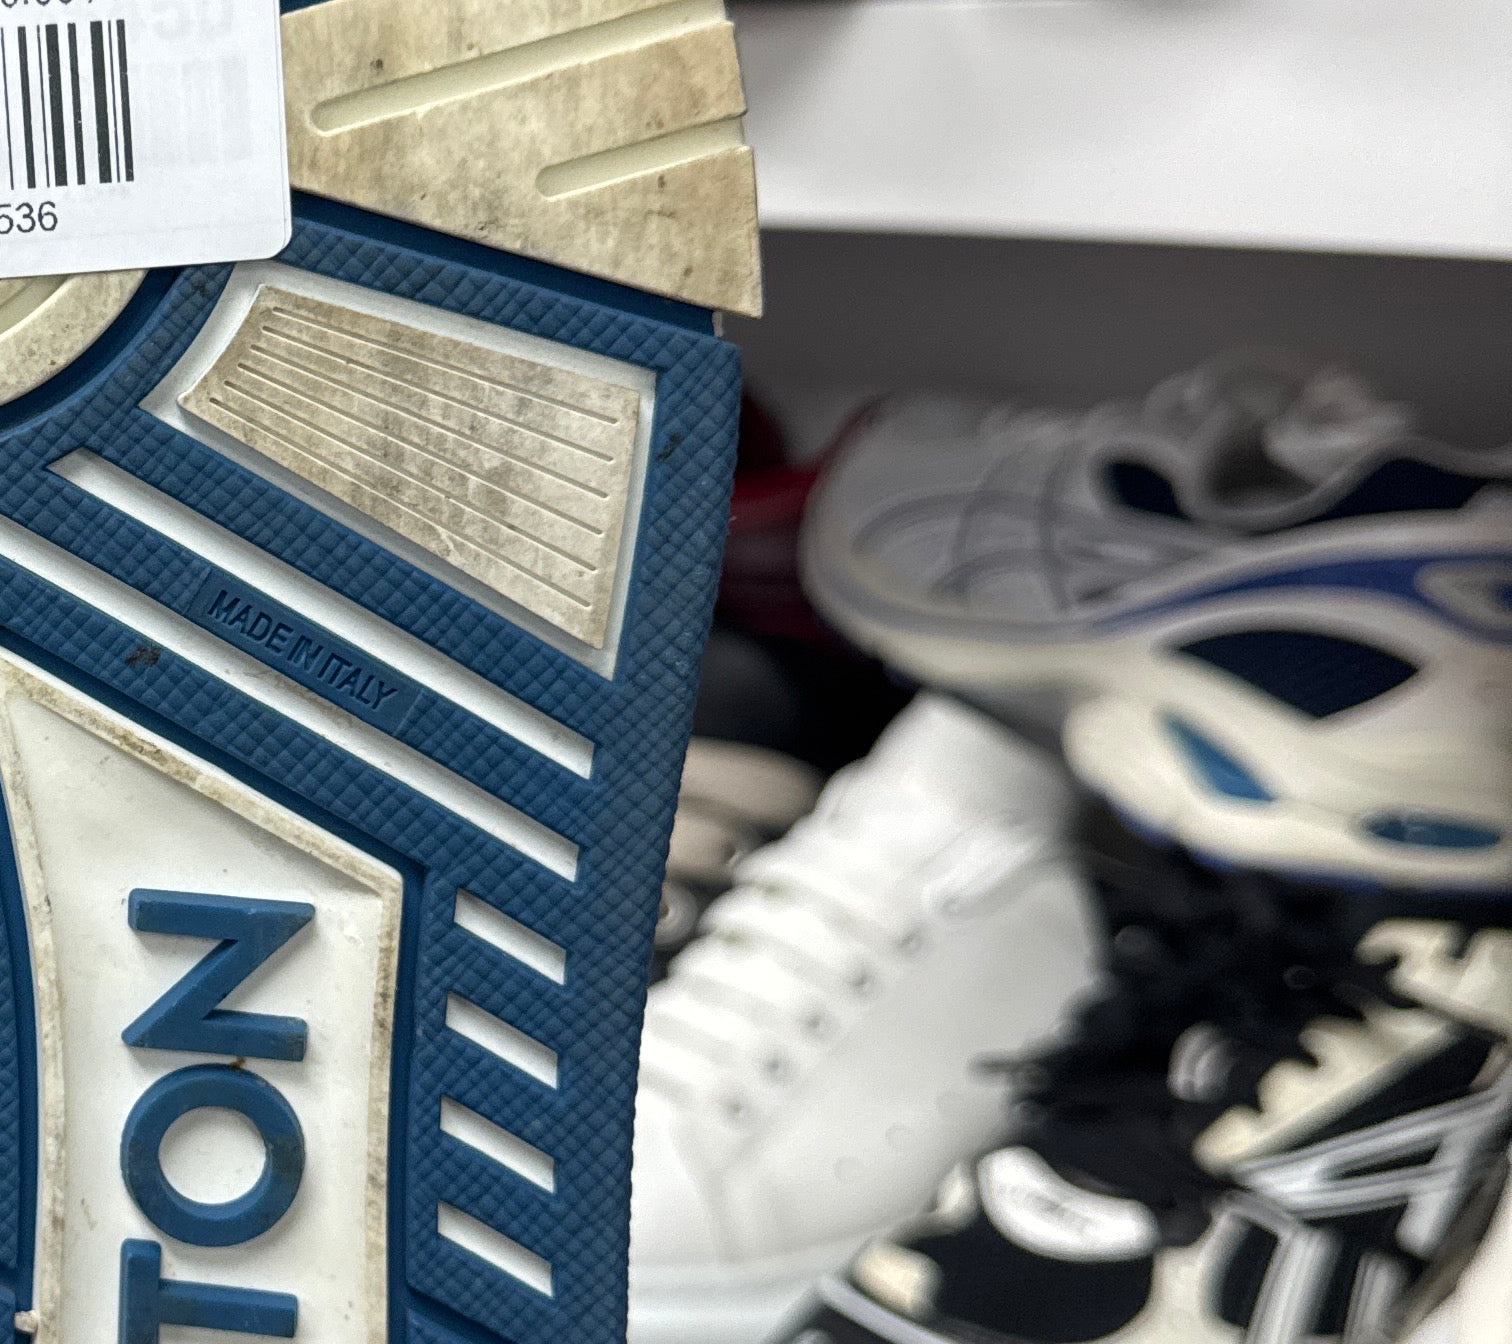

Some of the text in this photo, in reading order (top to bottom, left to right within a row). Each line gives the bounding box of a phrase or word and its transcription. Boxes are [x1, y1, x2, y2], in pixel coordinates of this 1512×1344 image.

[206, 588, 399, 711] MADE IN ITALY
